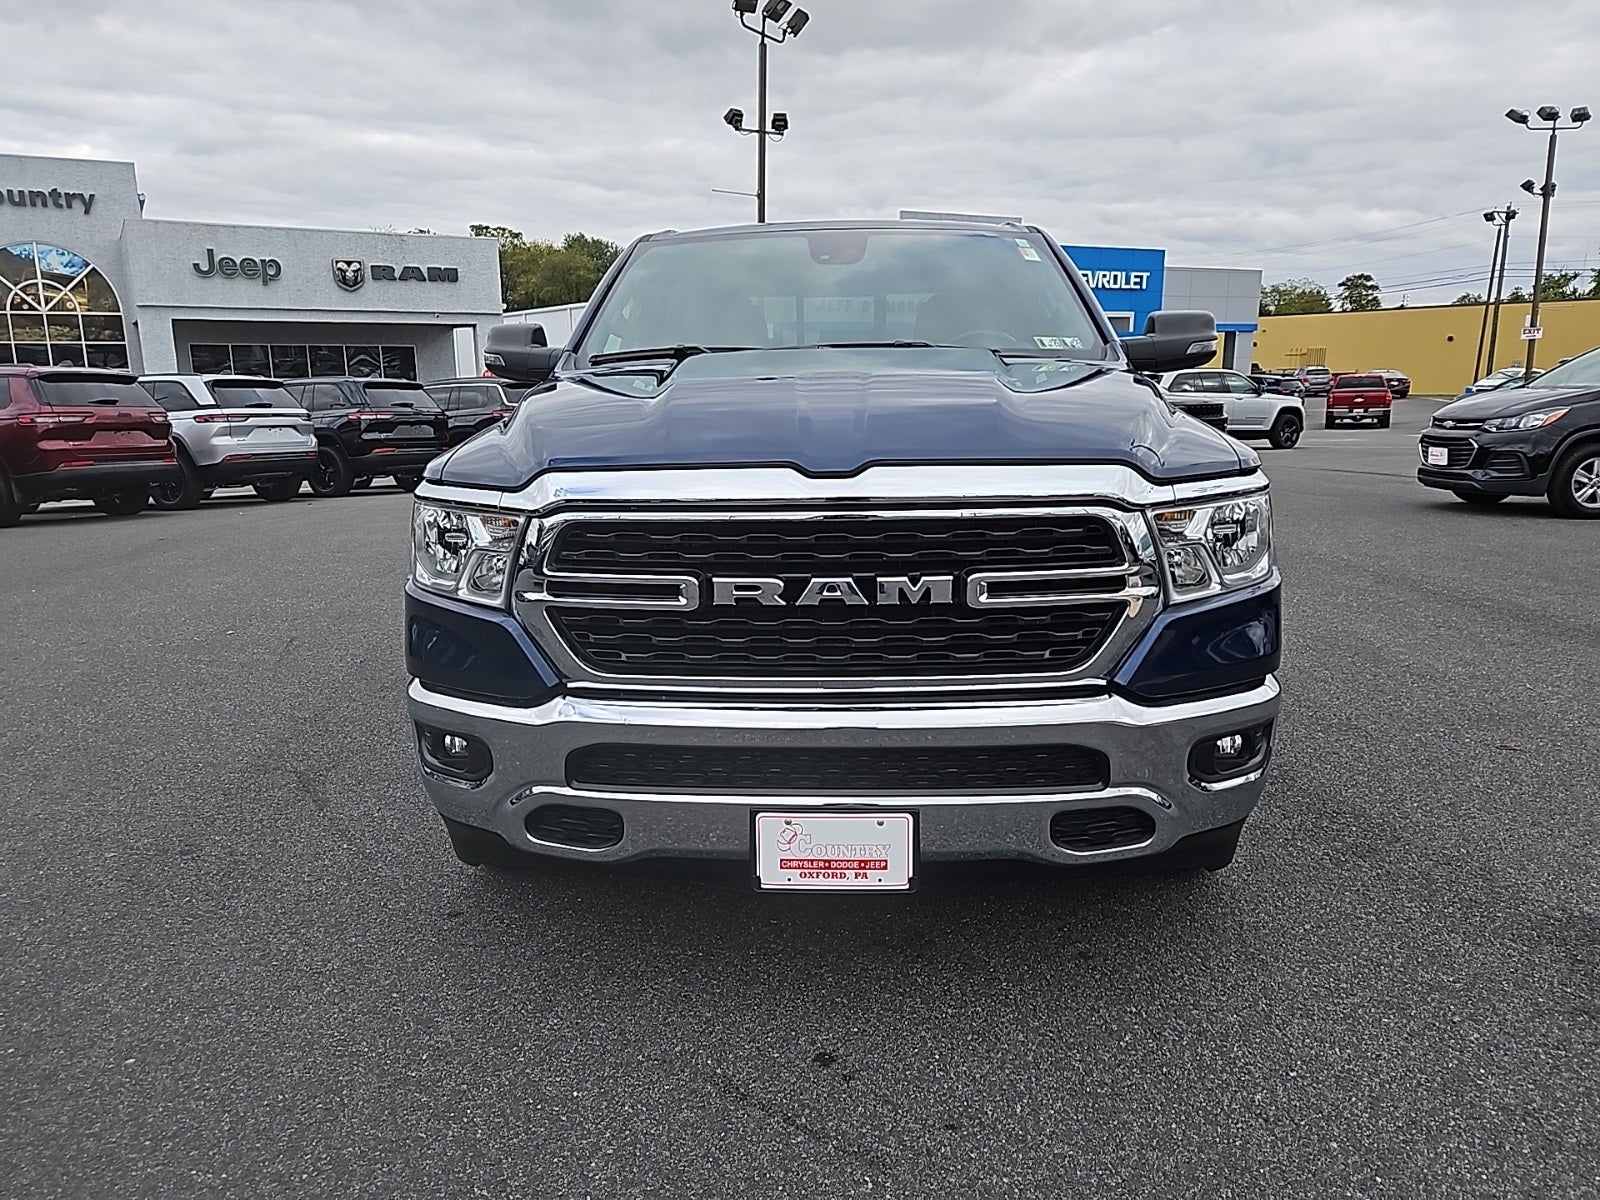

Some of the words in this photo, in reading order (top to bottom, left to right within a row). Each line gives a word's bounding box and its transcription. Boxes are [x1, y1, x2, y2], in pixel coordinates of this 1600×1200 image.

[192, 248, 282, 286] Jeep
[370, 264, 459, 282] RAM
[1079, 270, 1151, 289] VROLET
[712, 576, 954, 606] RAM
[781, 860, 825, 868] CHRYSLER
[830, 861, 860, 869] DODGE
[865, 861, 887, 869] JEEP
[799, 871, 850, 880] OXFORD,
[853, 871, 869, 880] PA
